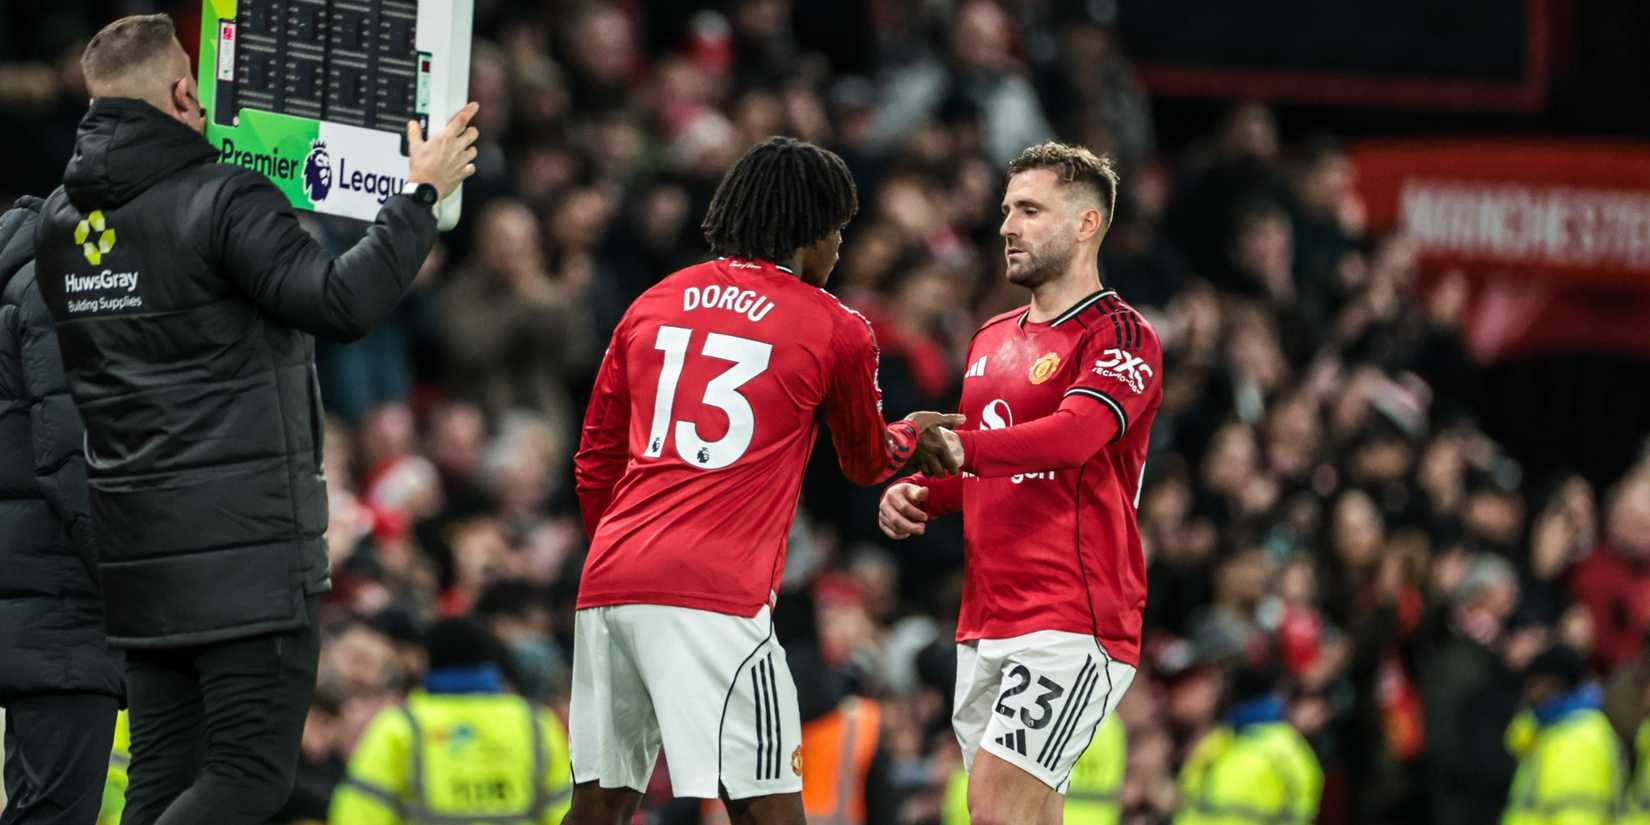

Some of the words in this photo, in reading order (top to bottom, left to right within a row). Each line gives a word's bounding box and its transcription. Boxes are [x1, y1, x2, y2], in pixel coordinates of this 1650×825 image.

[222, 138, 299, 180] Premier
[339, 158, 406, 204] Leagu
[65, 269, 139, 292] HuwsGray
[68, 299, 98, 312] Building
[99, 296, 142, 310] Supplies
[684, 285, 775, 322] DORGU
[1096, 348, 1152, 391] DXC
[643, 325, 774, 470] 13
[995, 665, 1064, 730] 23
